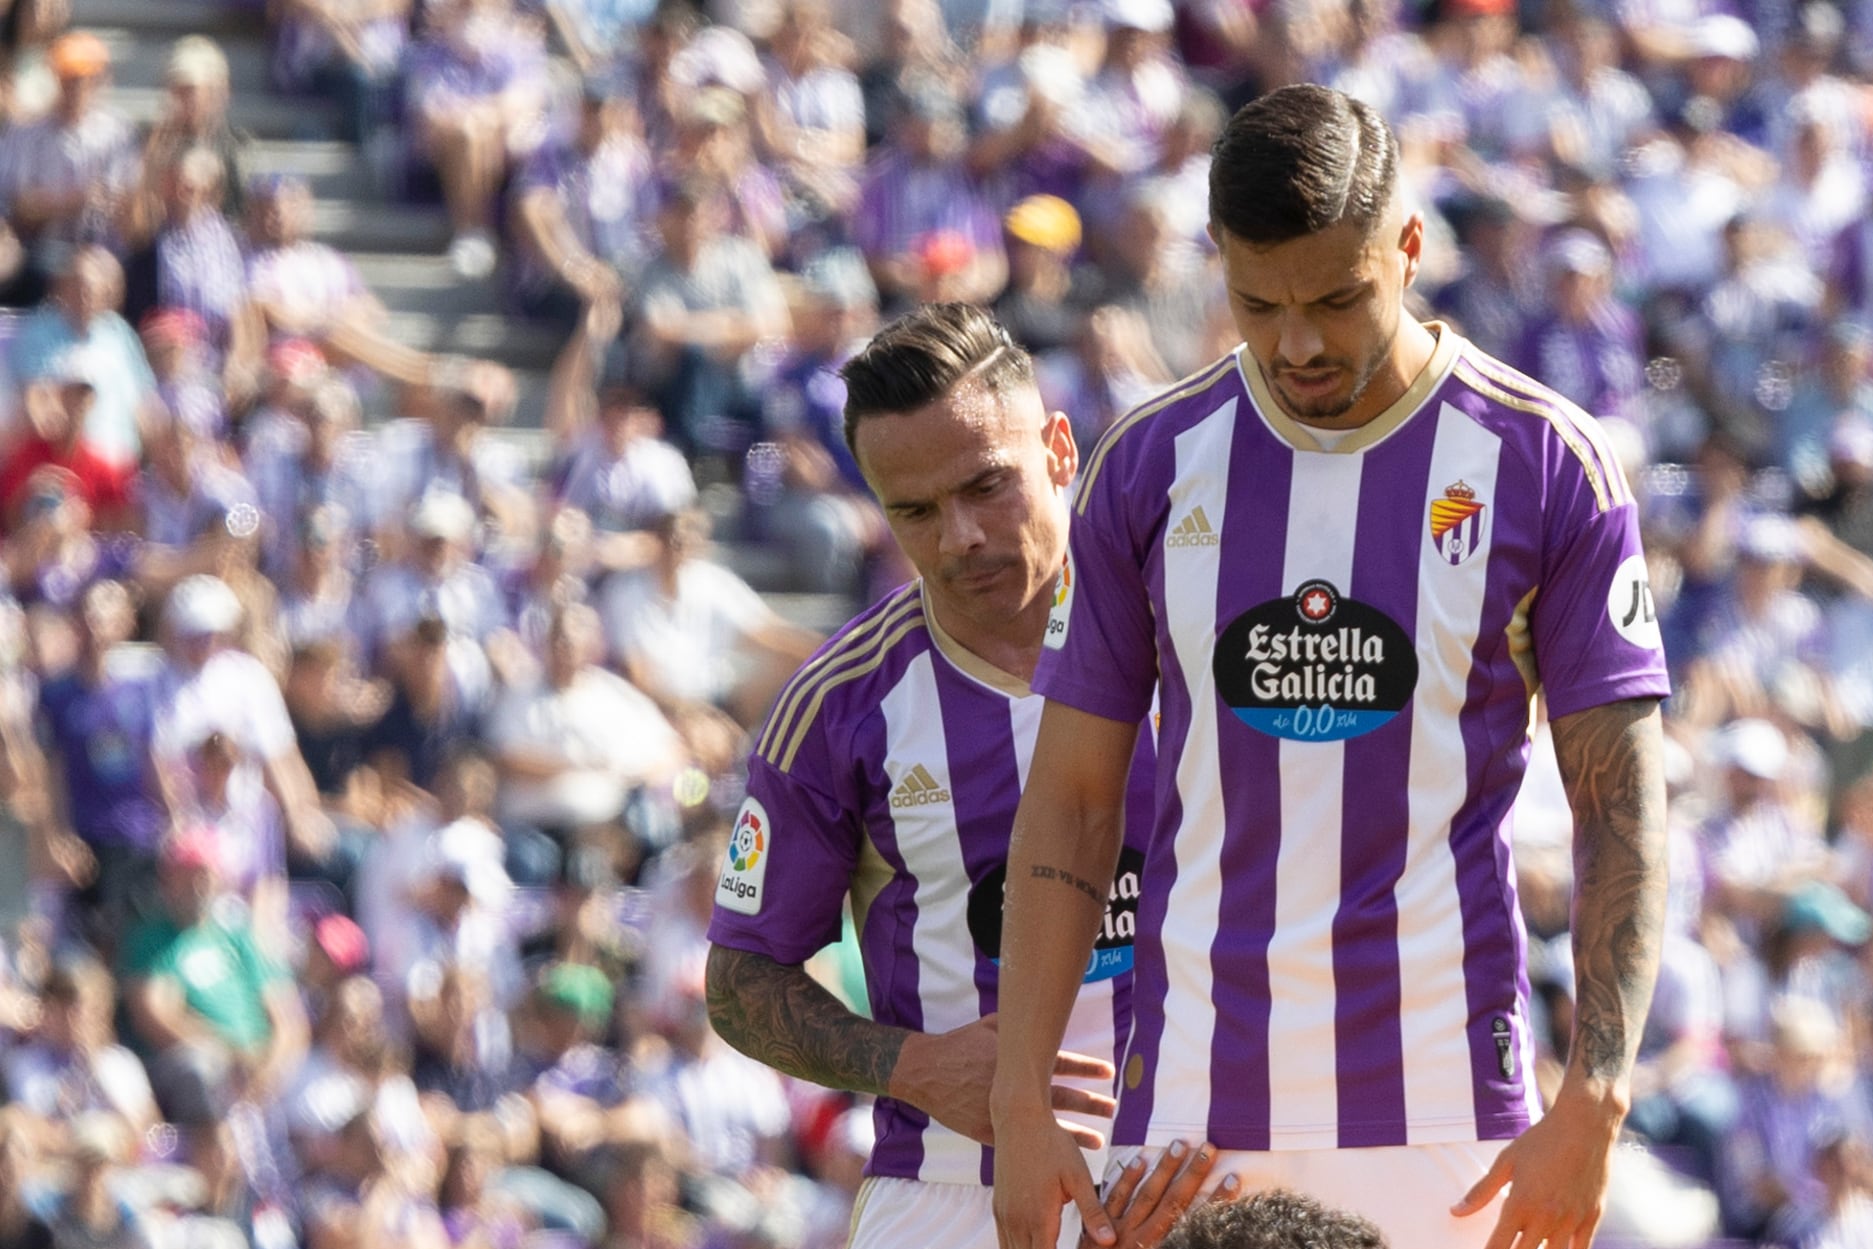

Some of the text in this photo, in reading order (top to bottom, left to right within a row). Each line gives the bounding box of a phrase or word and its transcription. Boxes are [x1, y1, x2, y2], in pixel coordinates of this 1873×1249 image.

[1166, 532, 1219, 548] adidas
[1245, 623, 1384, 664] Estrella
[1250, 661, 1376, 701] Galicia
[891, 787, 951, 809] adidas
[721, 873, 757, 899] LaLiga
